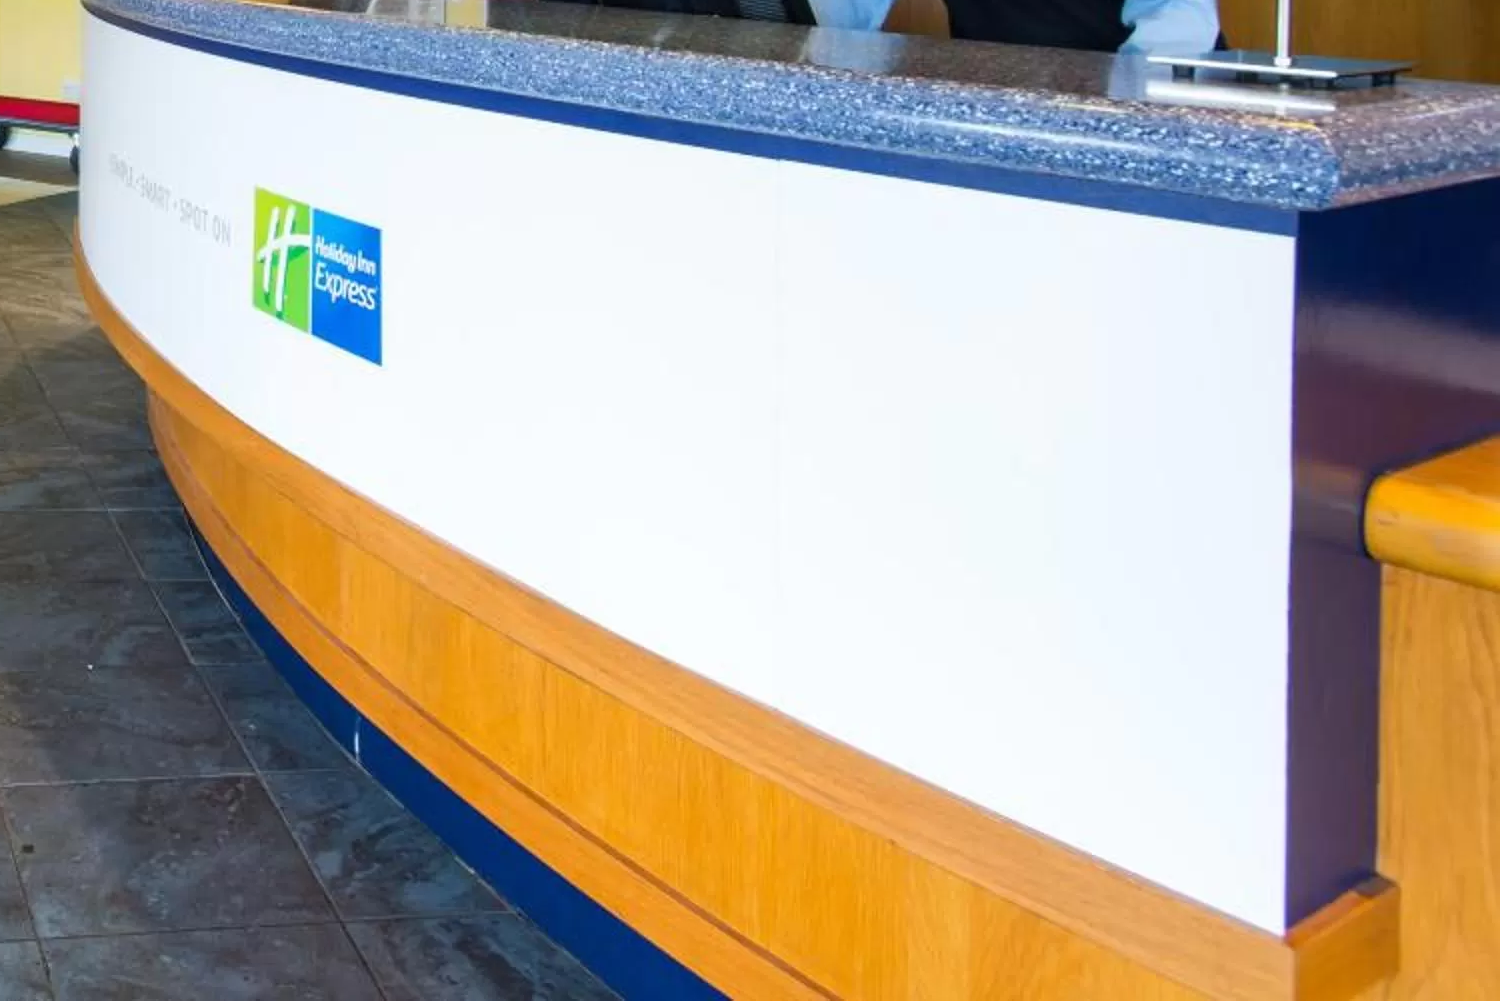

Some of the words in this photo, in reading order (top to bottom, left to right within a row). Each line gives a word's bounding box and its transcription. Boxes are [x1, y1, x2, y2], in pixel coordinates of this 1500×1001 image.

[180, 198, 209, 232] SPOT
[212, 214, 231, 248] ON
[315, 235, 356, 274] Holiday
[357, 250, 377, 276] Inn
[314, 261, 377, 311] Express
